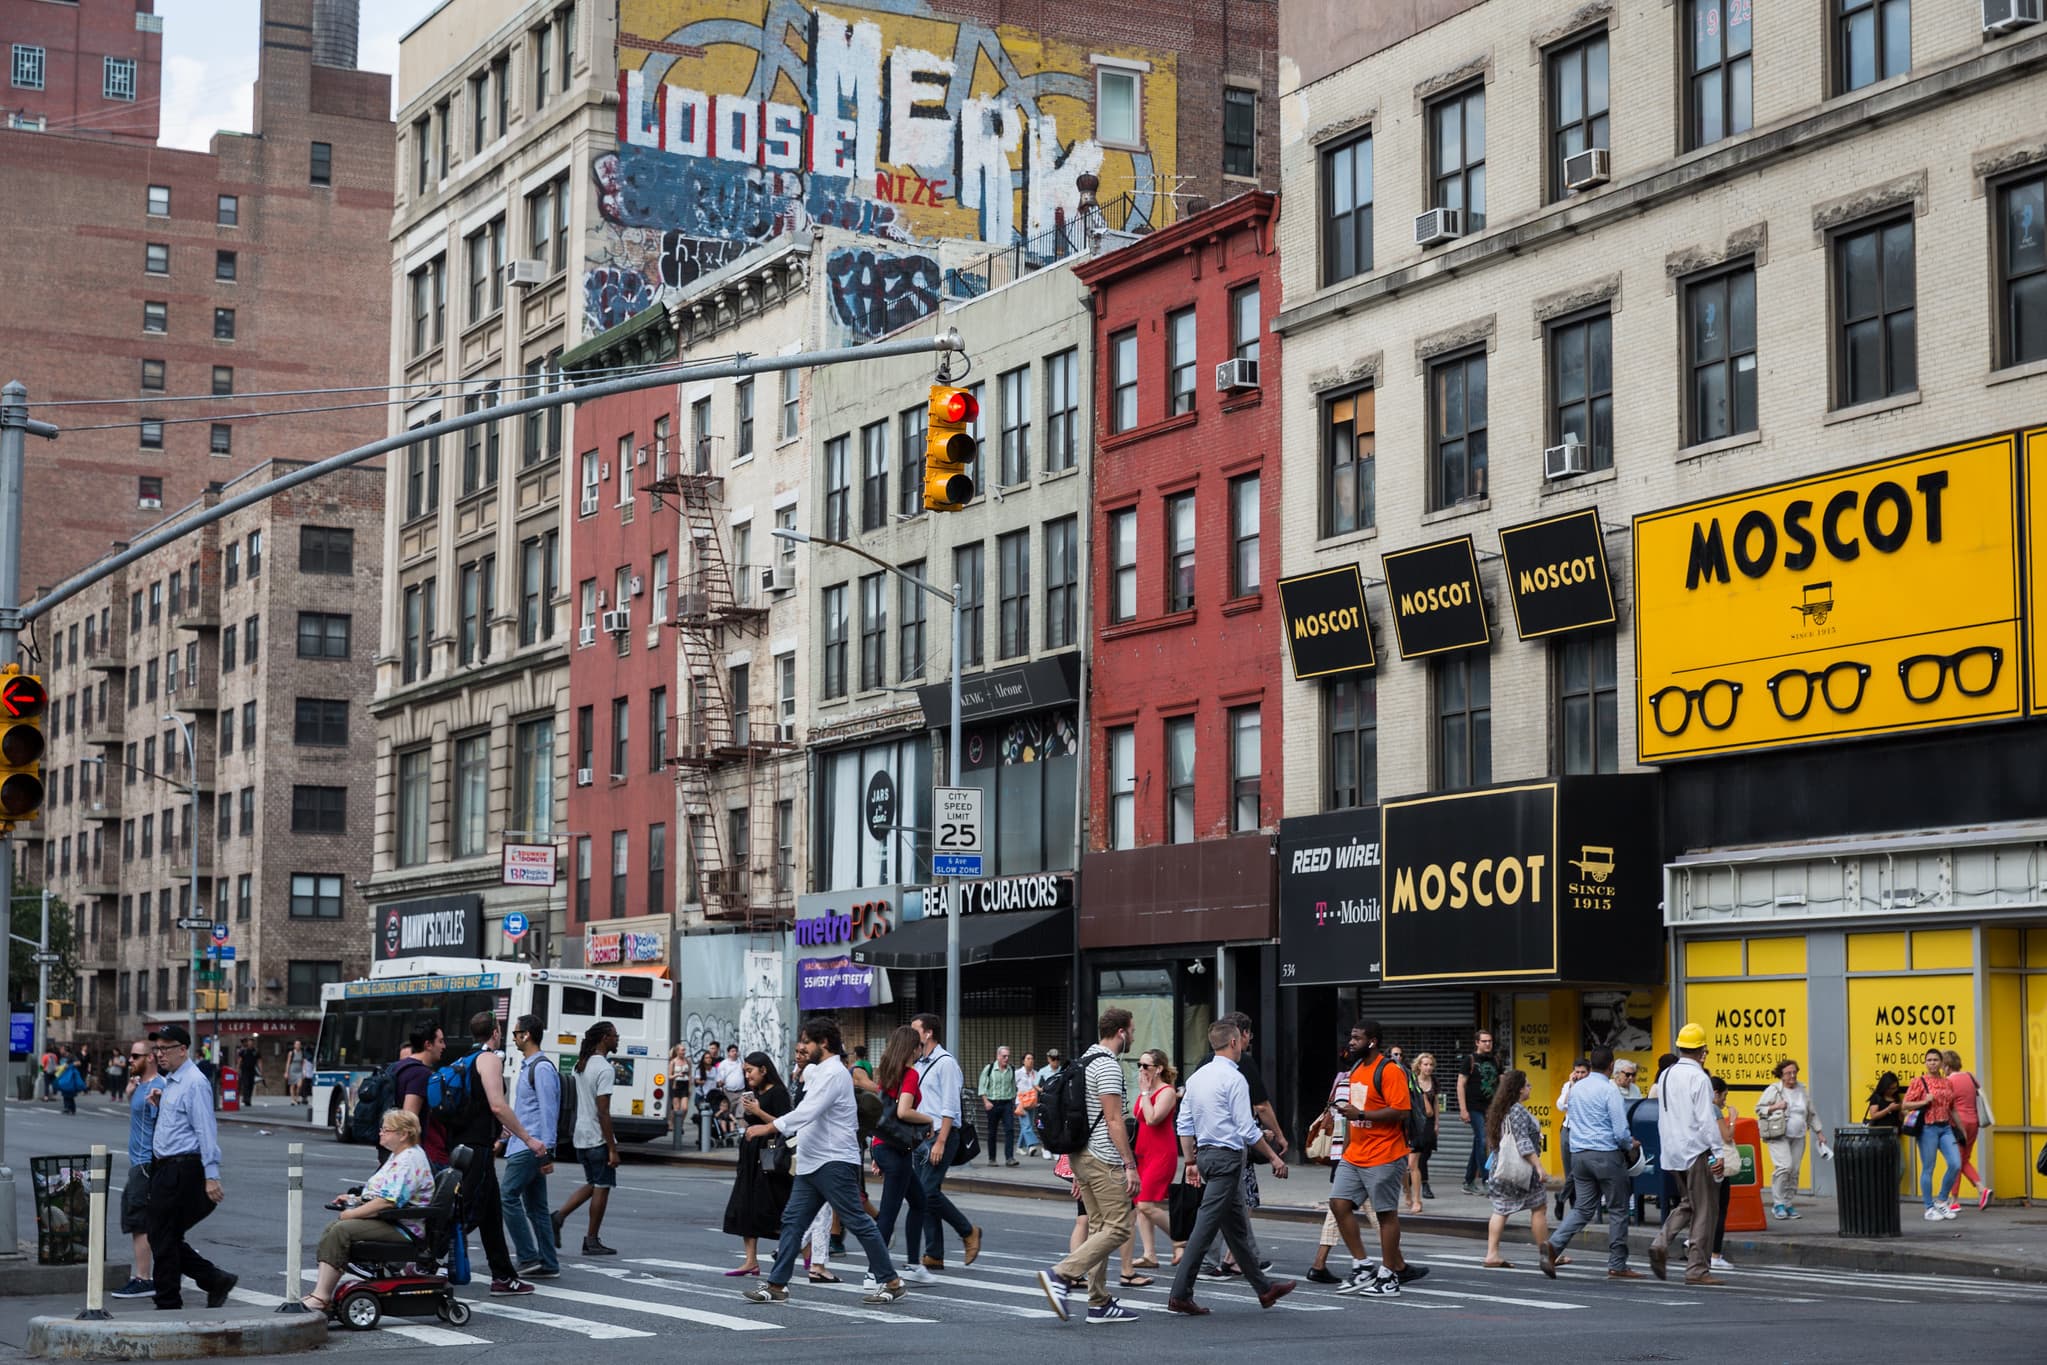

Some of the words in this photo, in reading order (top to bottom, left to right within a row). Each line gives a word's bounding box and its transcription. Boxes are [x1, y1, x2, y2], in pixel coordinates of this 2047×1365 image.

[876, 171, 948, 208] NIZE
[1686, 470, 1948, 590] MOSCOT
[1519, 555, 1597, 595] MOSCOT
[1401, 581, 1472, 617] MOSCOT
[1295, 607, 1359, 640] MOSCOT
[994, 683, 1023, 699] Alcone
[872, 788, 889, 803] JARS
[948, 792, 968, 801] CITY
[944, 802, 973, 811] SPEED
[872, 808, 888, 824] dani
[947, 813, 970, 821] LIMIT
[940, 823, 976, 847] 25
[1291, 847, 1332, 874] REED
[936, 866, 957, 874] SLOW
[959, 866, 980, 874] ZONE
[1391, 855, 1545, 914] MOSCOT
[922, 883, 975, 917] BEATY
[980, 875, 1058, 912] CURATORS
[1573, 898, 1612, 910] 1915
[401, 912, 435, 949] DANNY'S
[435, 909, 465, 947] CYCLES
[594, 978, 618, 988] 6779
[1715, 1008, 1786, 1028] MOSCOT
[1875, 1005, 1956, 1026] MOSCOT
[228, 1023, 252, 1031] LEFT
[262, 1023, 296, 1031] BANK
[1520, 1023, 1551, 1034] MOSCO
[1715, 1033, 1739, 1046] HAS
[1744, 1033, 1787, 1046] MOVED
[1875, 1031, 1902, 1045] HAS
[1908, 1031, 1957, 1045] MOVED
[1716, 1053, 1735, 1064] TWO
[1738, 1053, 1772, 1064] BLOCKS
[1876, 1053, 1897, 1064] TWO
[1735, 1069, 1752, 1080] 6TH
[1897, 1070, 1915, 1081] 6TH
